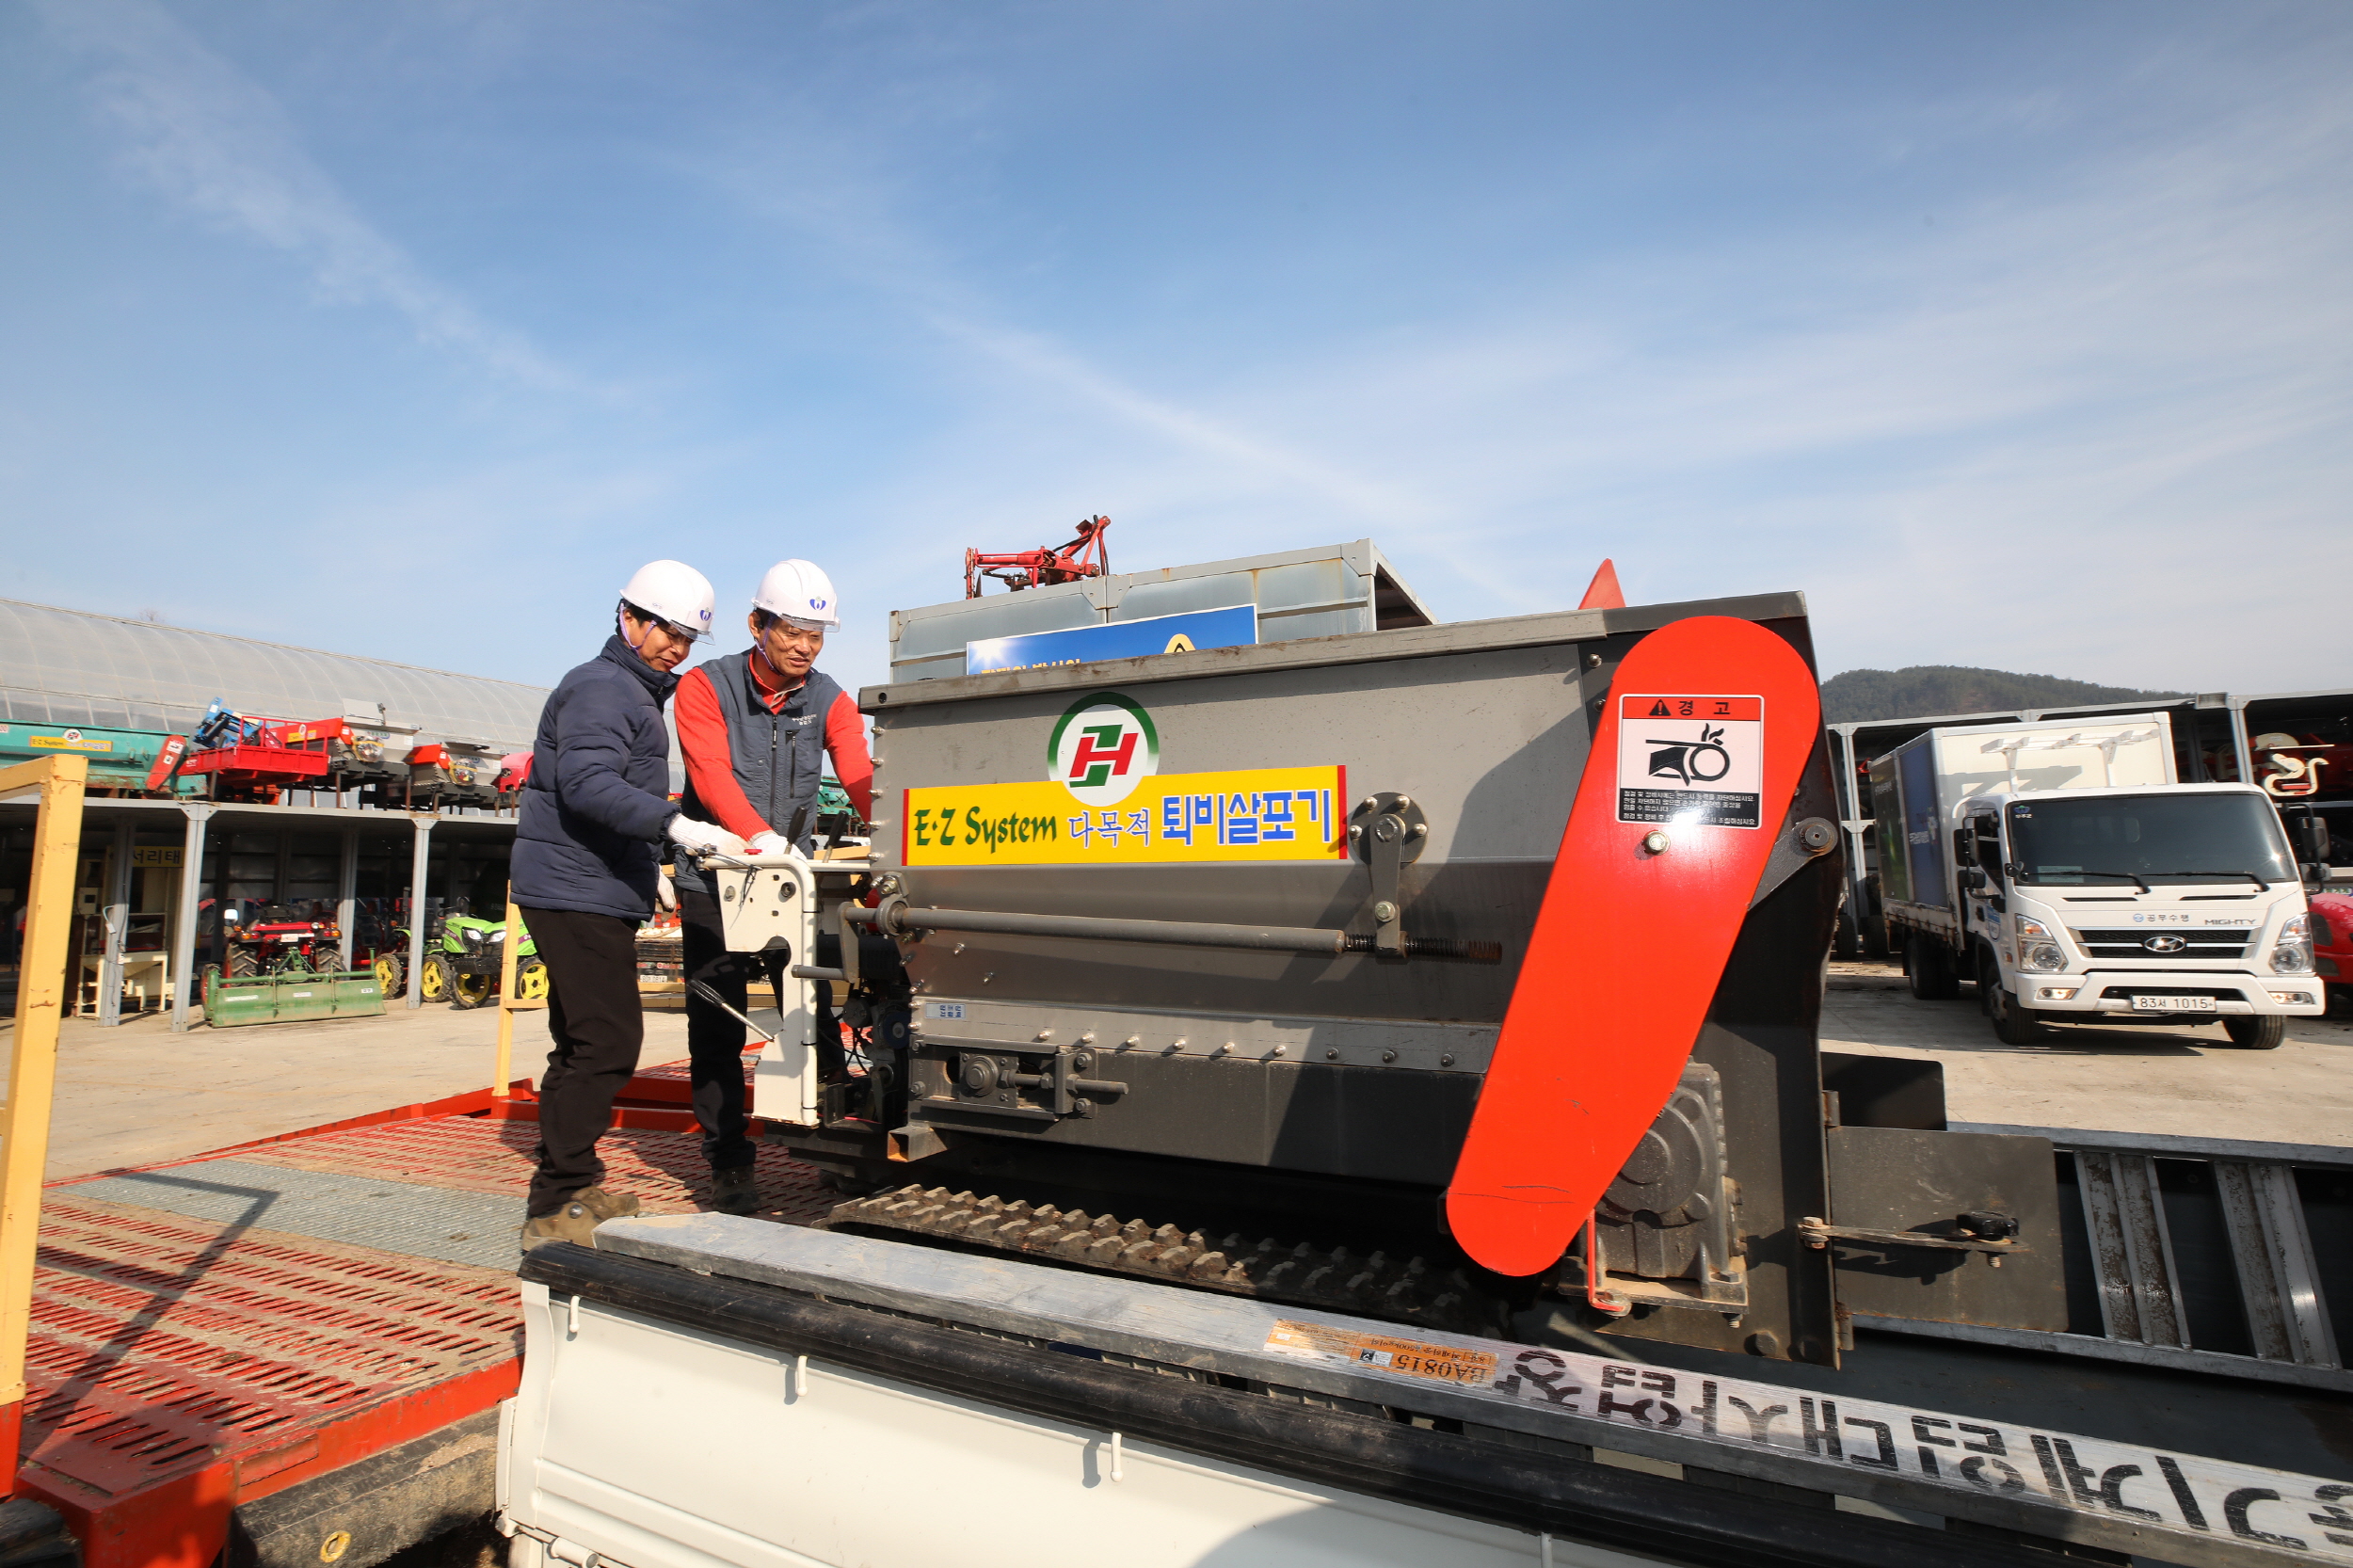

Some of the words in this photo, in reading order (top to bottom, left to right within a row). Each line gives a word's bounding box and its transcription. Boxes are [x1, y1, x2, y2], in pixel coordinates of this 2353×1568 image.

[965, 806, 1058, 853] System
[1067, 807, 1151, 849] 다목적
[1160, 789, 1333, 846] 퇴비살포기
[2147, 914, 2190, 922] 공무수행
[2140, 998, 2167, 1008] 83서
[2173, 998, 2208, 1009] 1015
[1395, 1354, 1487, 1384] BA0815
